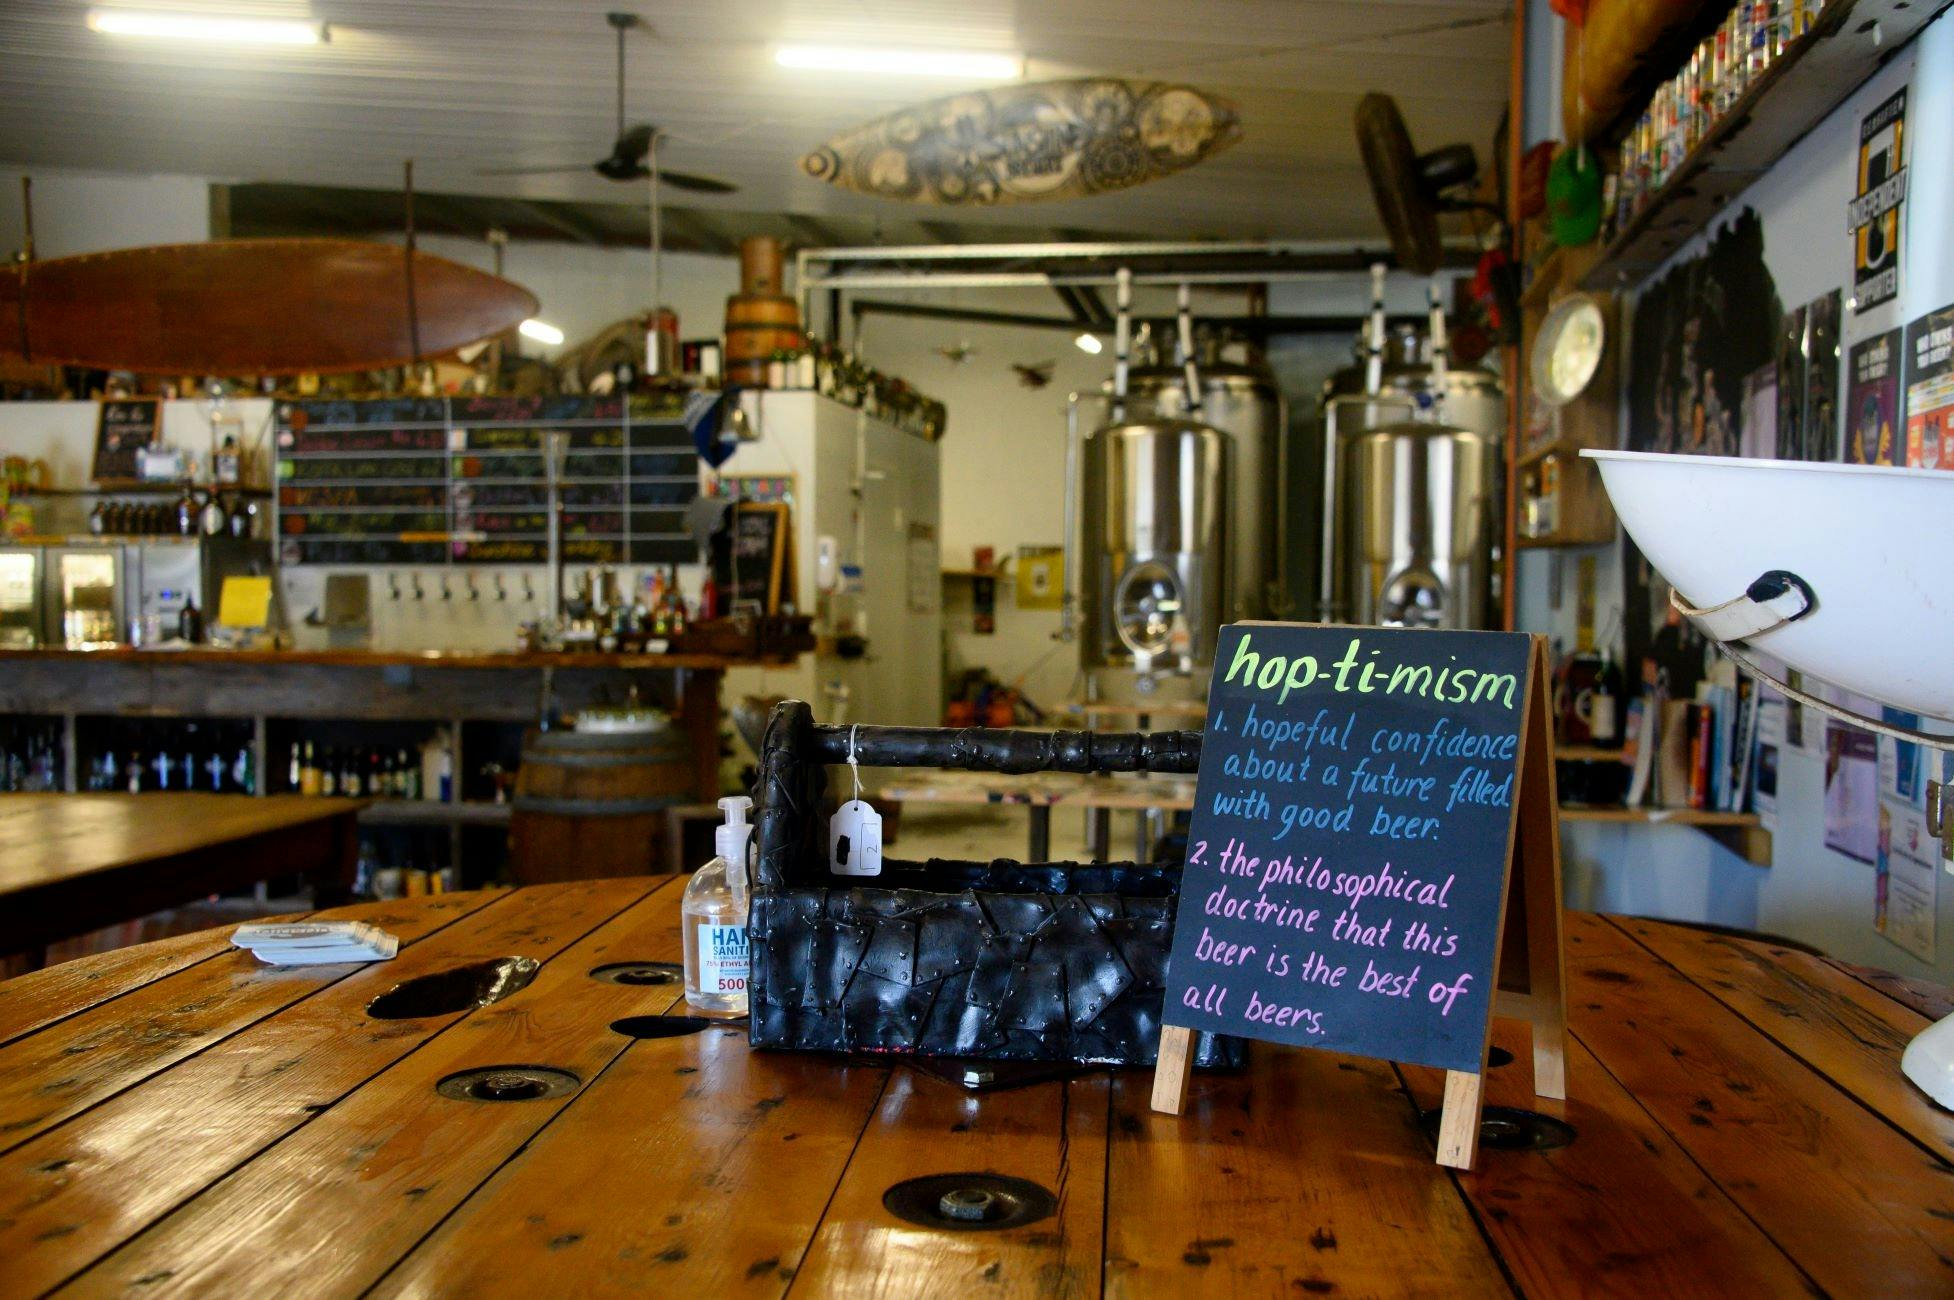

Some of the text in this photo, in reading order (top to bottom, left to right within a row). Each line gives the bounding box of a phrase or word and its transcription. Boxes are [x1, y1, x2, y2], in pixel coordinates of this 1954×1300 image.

[1224, 633, 1517, 709] hop-ti-mism
[1214, 704, 1517, 765] 1. hopeful confidence
[1224, 750, 1514, 812] about a future filled
[1214, 789, 1269, 820] with
[1273, 804, 1354, 841] good
[1189, 838, 1454, 909] 2. the philosophical
[1205, 886, 1458, 957] doctrine that this
[1195, 927, 1472, 1016] beer is the best of
[1183, 984, 1325, 1035] all beers.
